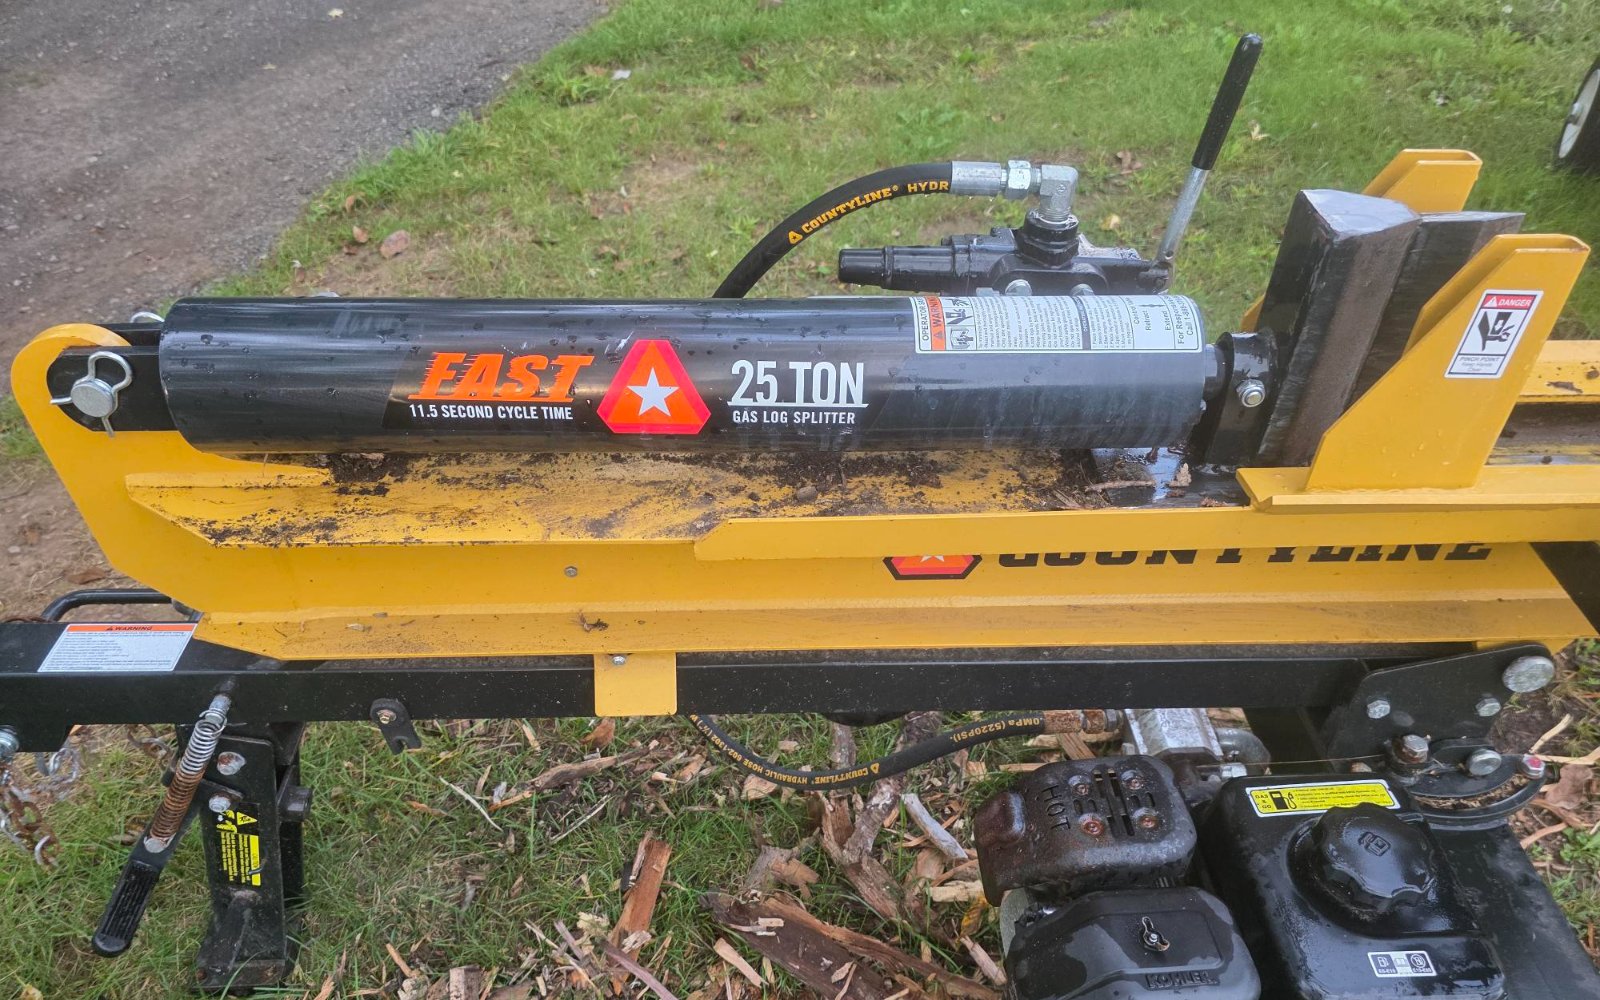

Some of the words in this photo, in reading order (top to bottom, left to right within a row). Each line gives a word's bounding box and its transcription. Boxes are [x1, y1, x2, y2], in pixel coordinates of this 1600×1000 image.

[907, 180, 949, 194] HYDR
[1498, 298, 1532, 307] DANGER
[920, 306, 929, 341] OPERATOR
[1144, 310, 1152, 331] Retract
[1163, 310, 1172, 331] Extend
[1185, 322, 1193, 336] Call
[1177, 331, 1185, 344] For
[408, 352, 595, 402] FAST
[731, 359, 778, 404] 25
[789, 361, 864, 405] TON
[409, 404, 438, 418] 11.5
[441, 404, 493, 419] SECOND
[497, 405, 539, 420] CYCLE
[541, 406, 574, 420] TIME
[732, 410, 758, 423] GAS
[763, 410, 788, 423] LOG
[793, 411, 856, 424] SPLITTER
[742, 759, 763, 774] HOSE
[765, 768, 808, 785] HYDRAULIC
[1041, 784, 1071, 830] HOT
